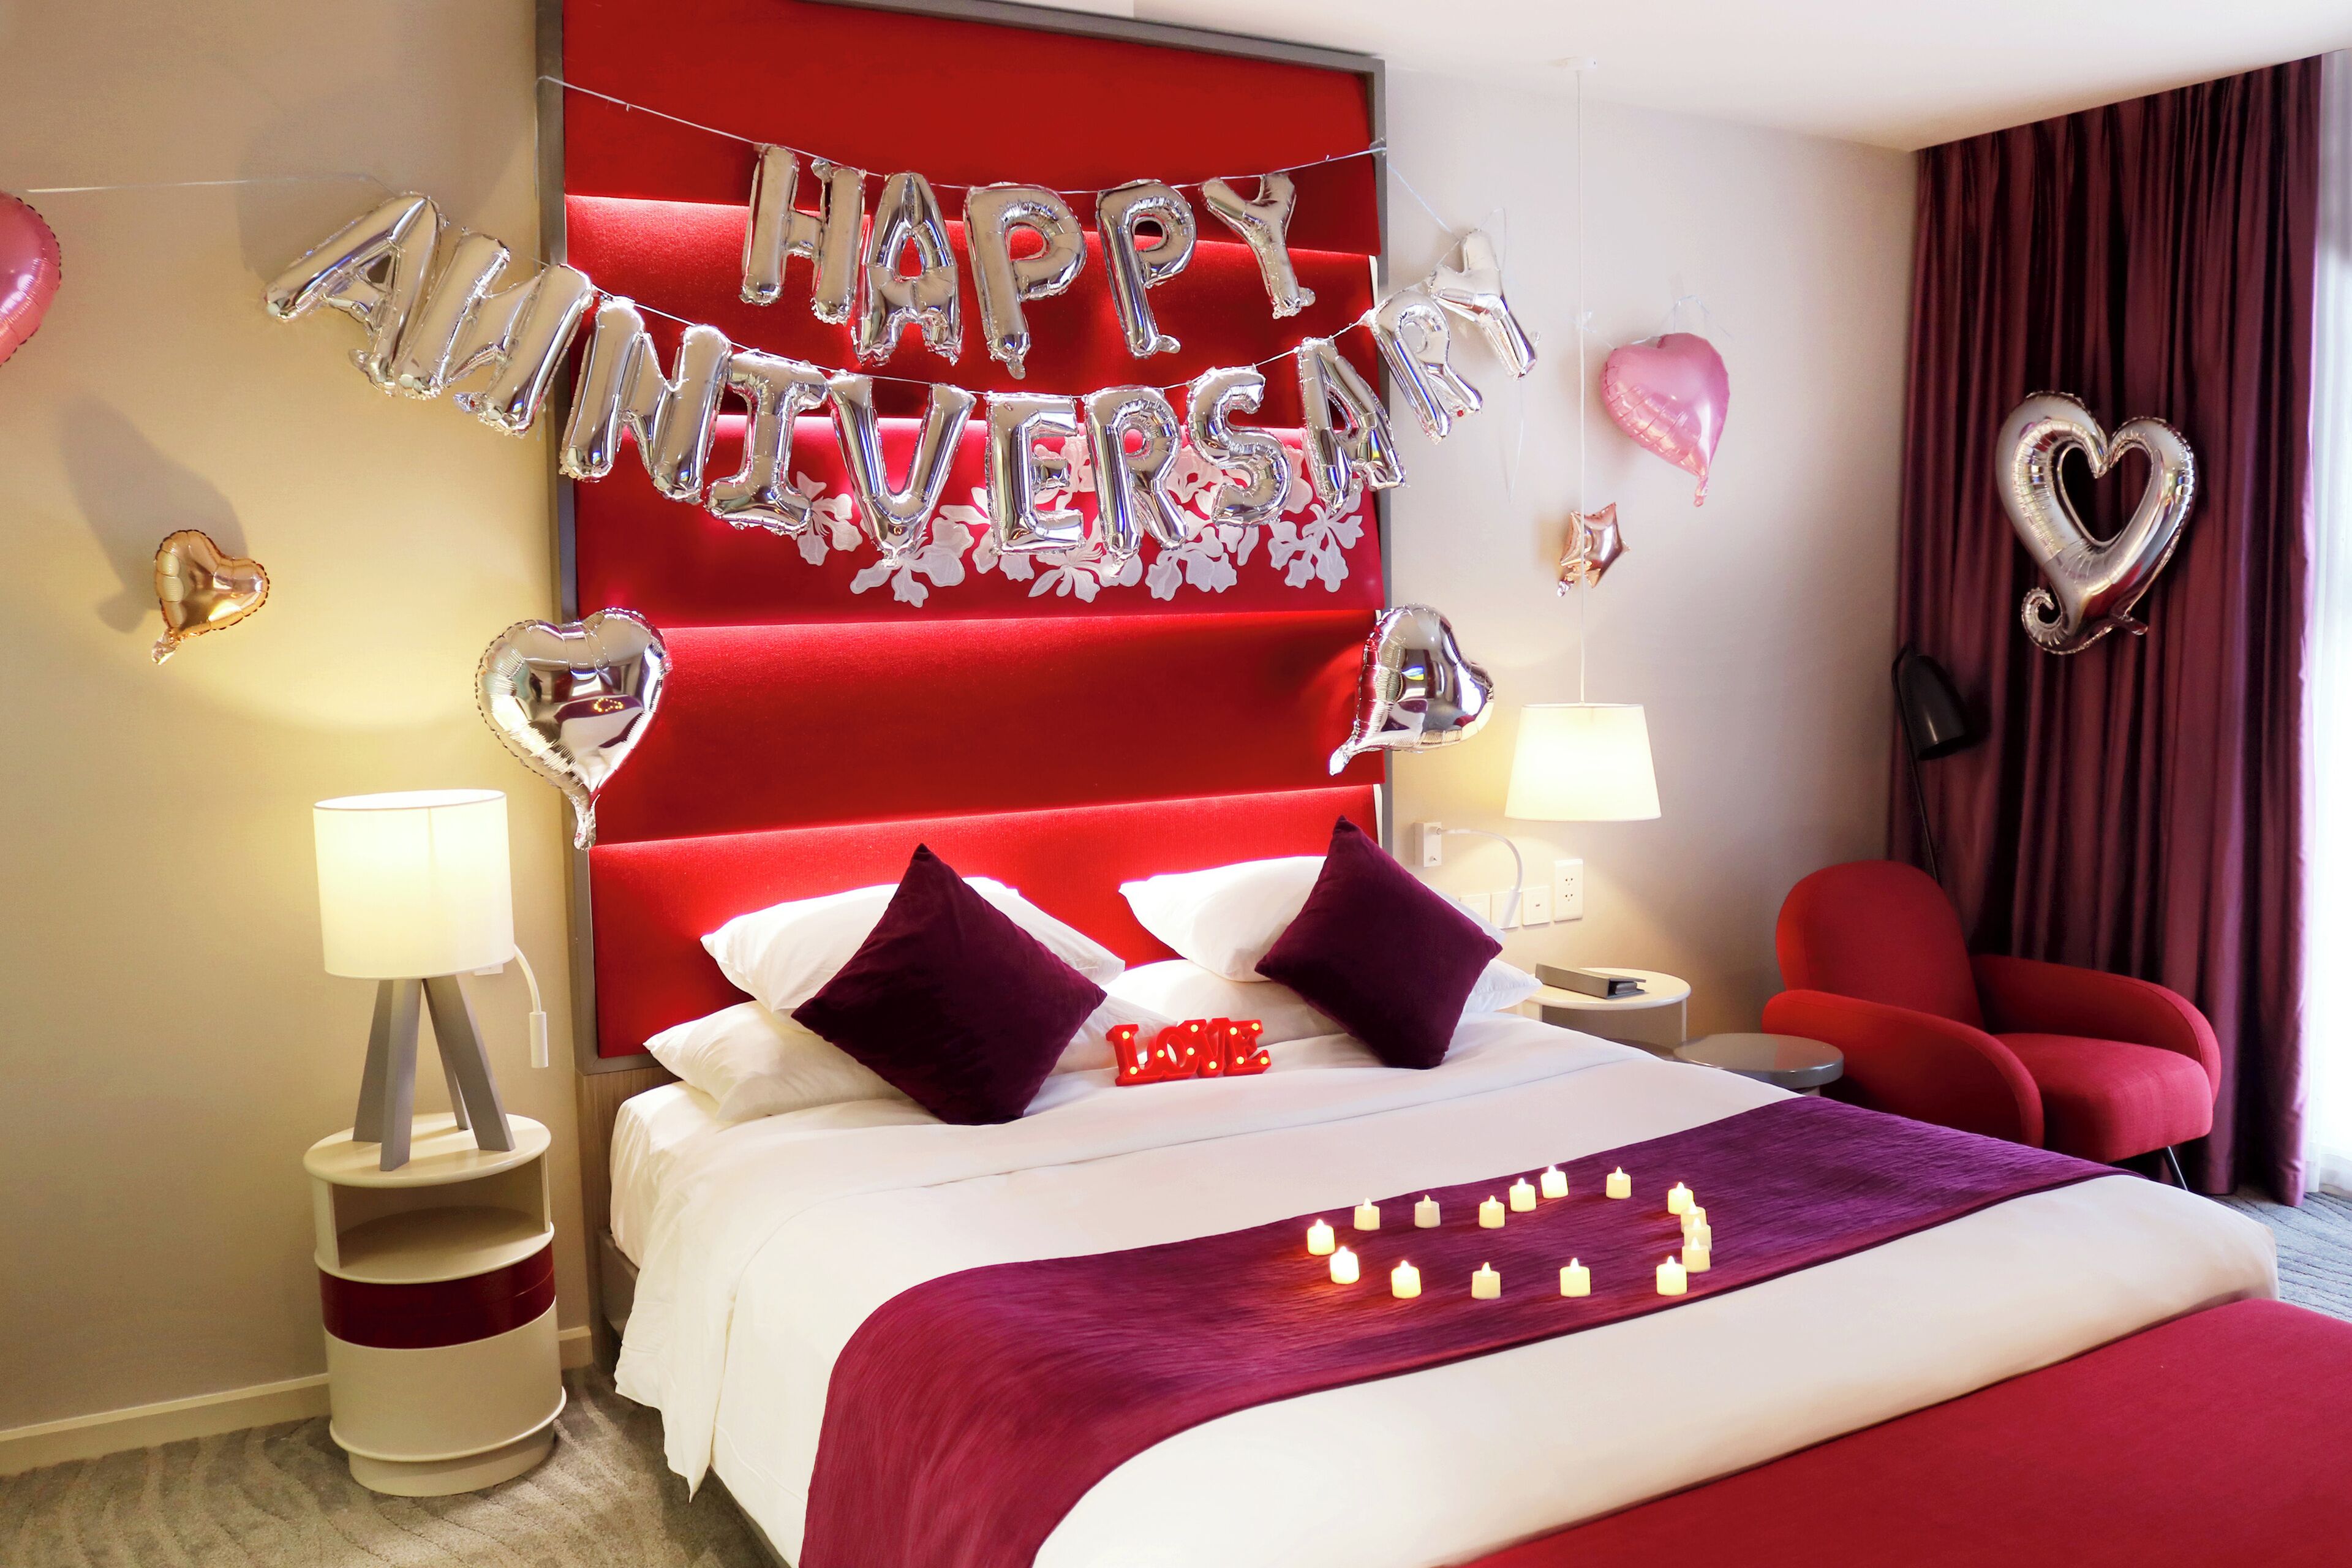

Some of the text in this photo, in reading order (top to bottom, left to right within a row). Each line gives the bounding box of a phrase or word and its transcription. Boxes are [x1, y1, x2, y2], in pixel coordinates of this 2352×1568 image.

[738, 143, 1316, 379] HAPPY
[263, 190, 1541, 578] ANNIVERSARY
[1106, 1017, 1272, 1086] LOVE
